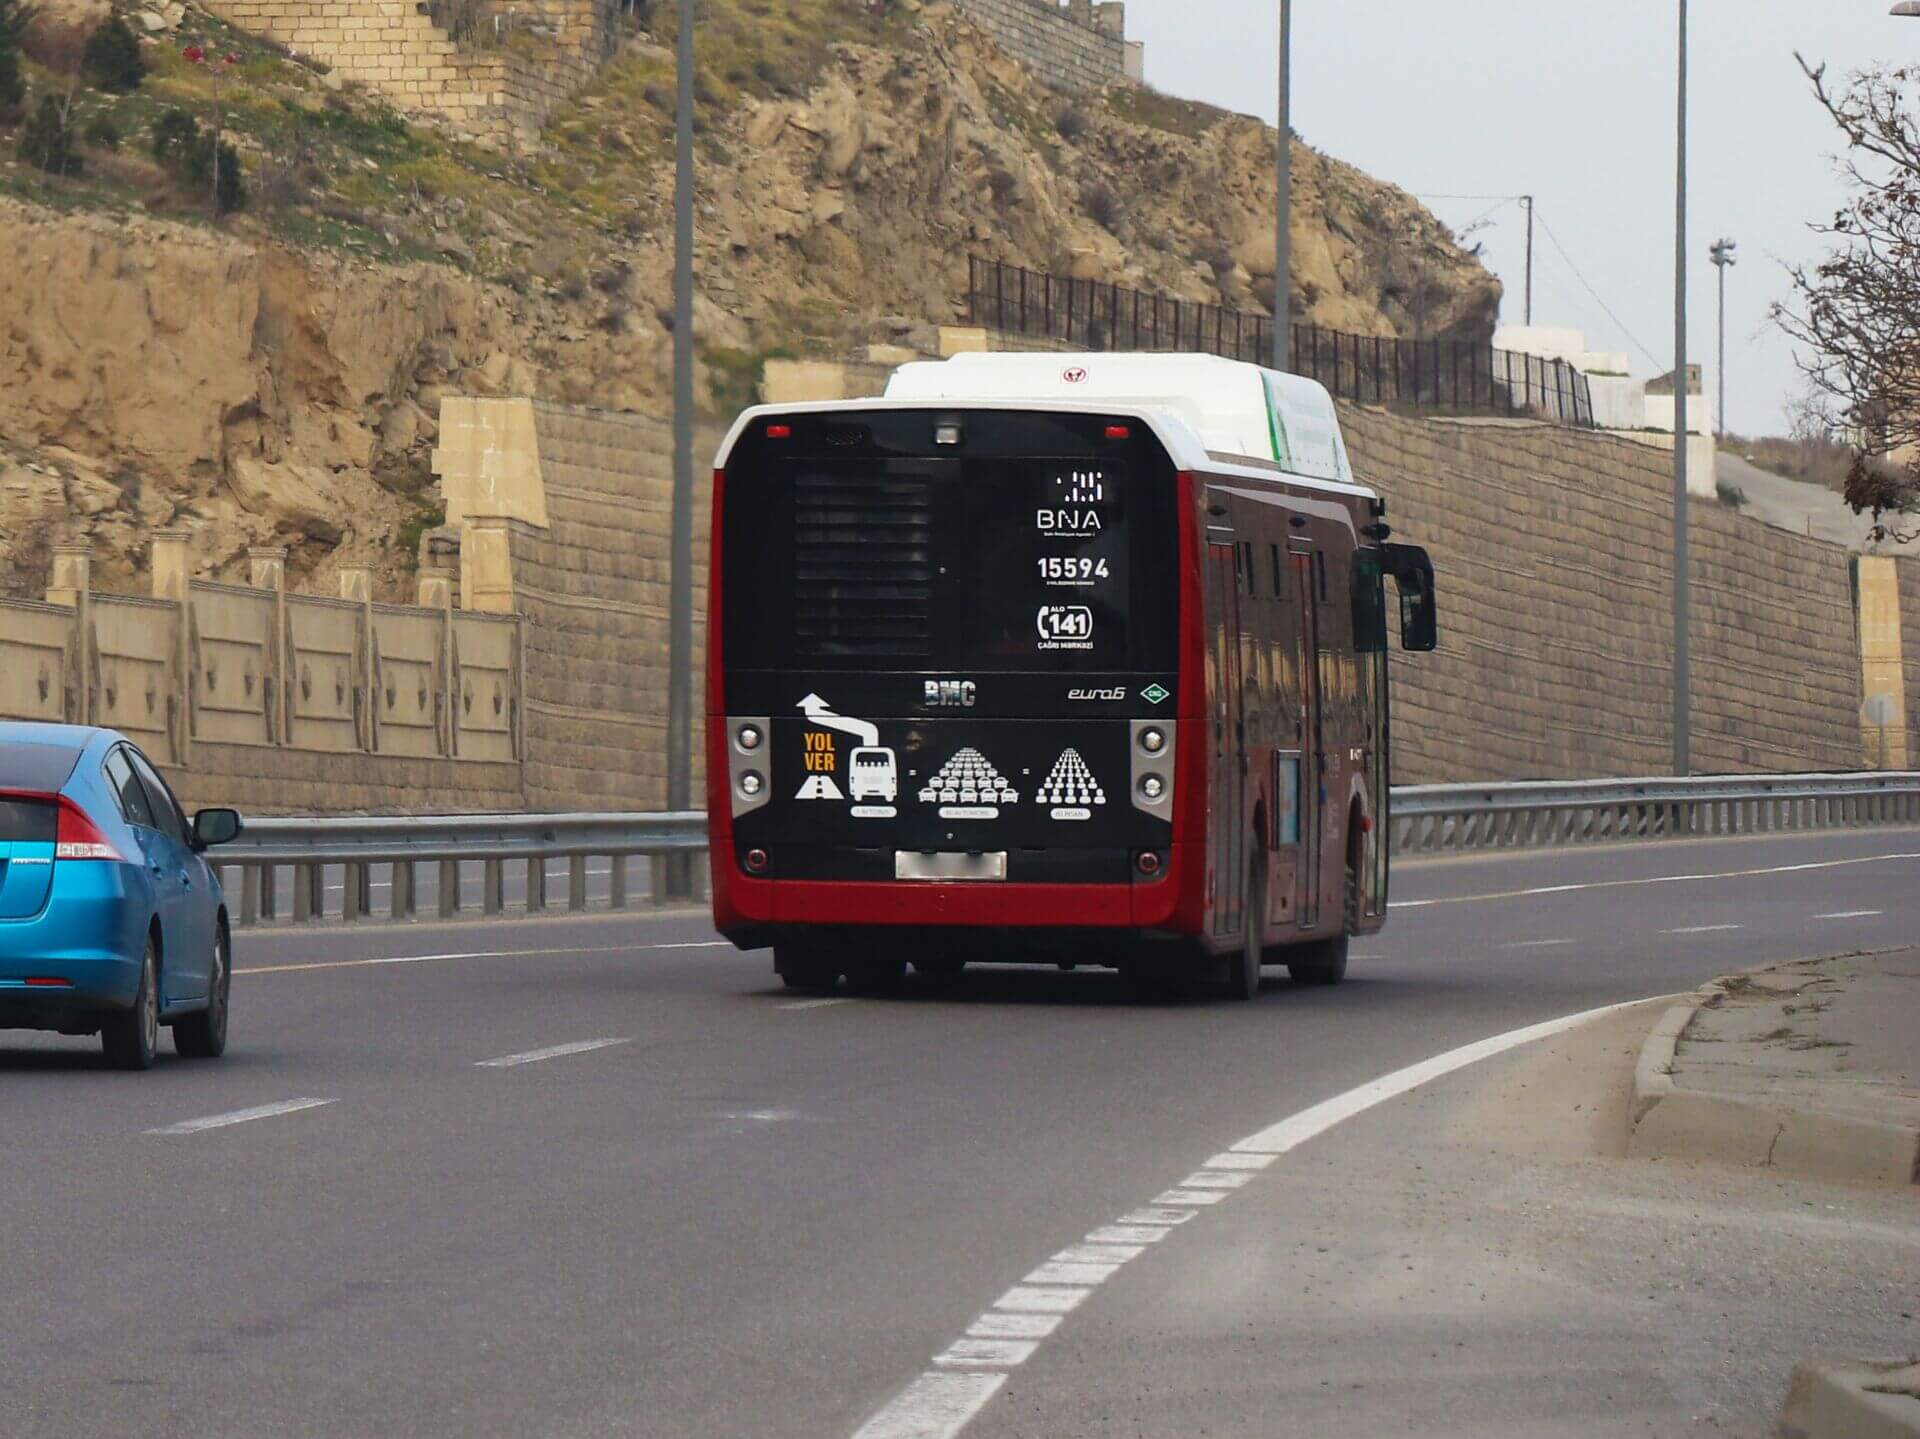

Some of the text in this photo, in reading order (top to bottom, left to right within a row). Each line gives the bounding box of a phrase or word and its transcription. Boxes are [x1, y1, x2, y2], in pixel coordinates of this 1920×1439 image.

[1037, 509, 1101, 529] BNA
[1038, 558, 1109, 578] 15594
[1049, 613, 1087, 634] 141
[924, 681, 976, 705] BMC
[1067, 687, 1126, 700] euro6
[804, 733, 835, 751] YOL
[804, 753, 835, 771] VER
